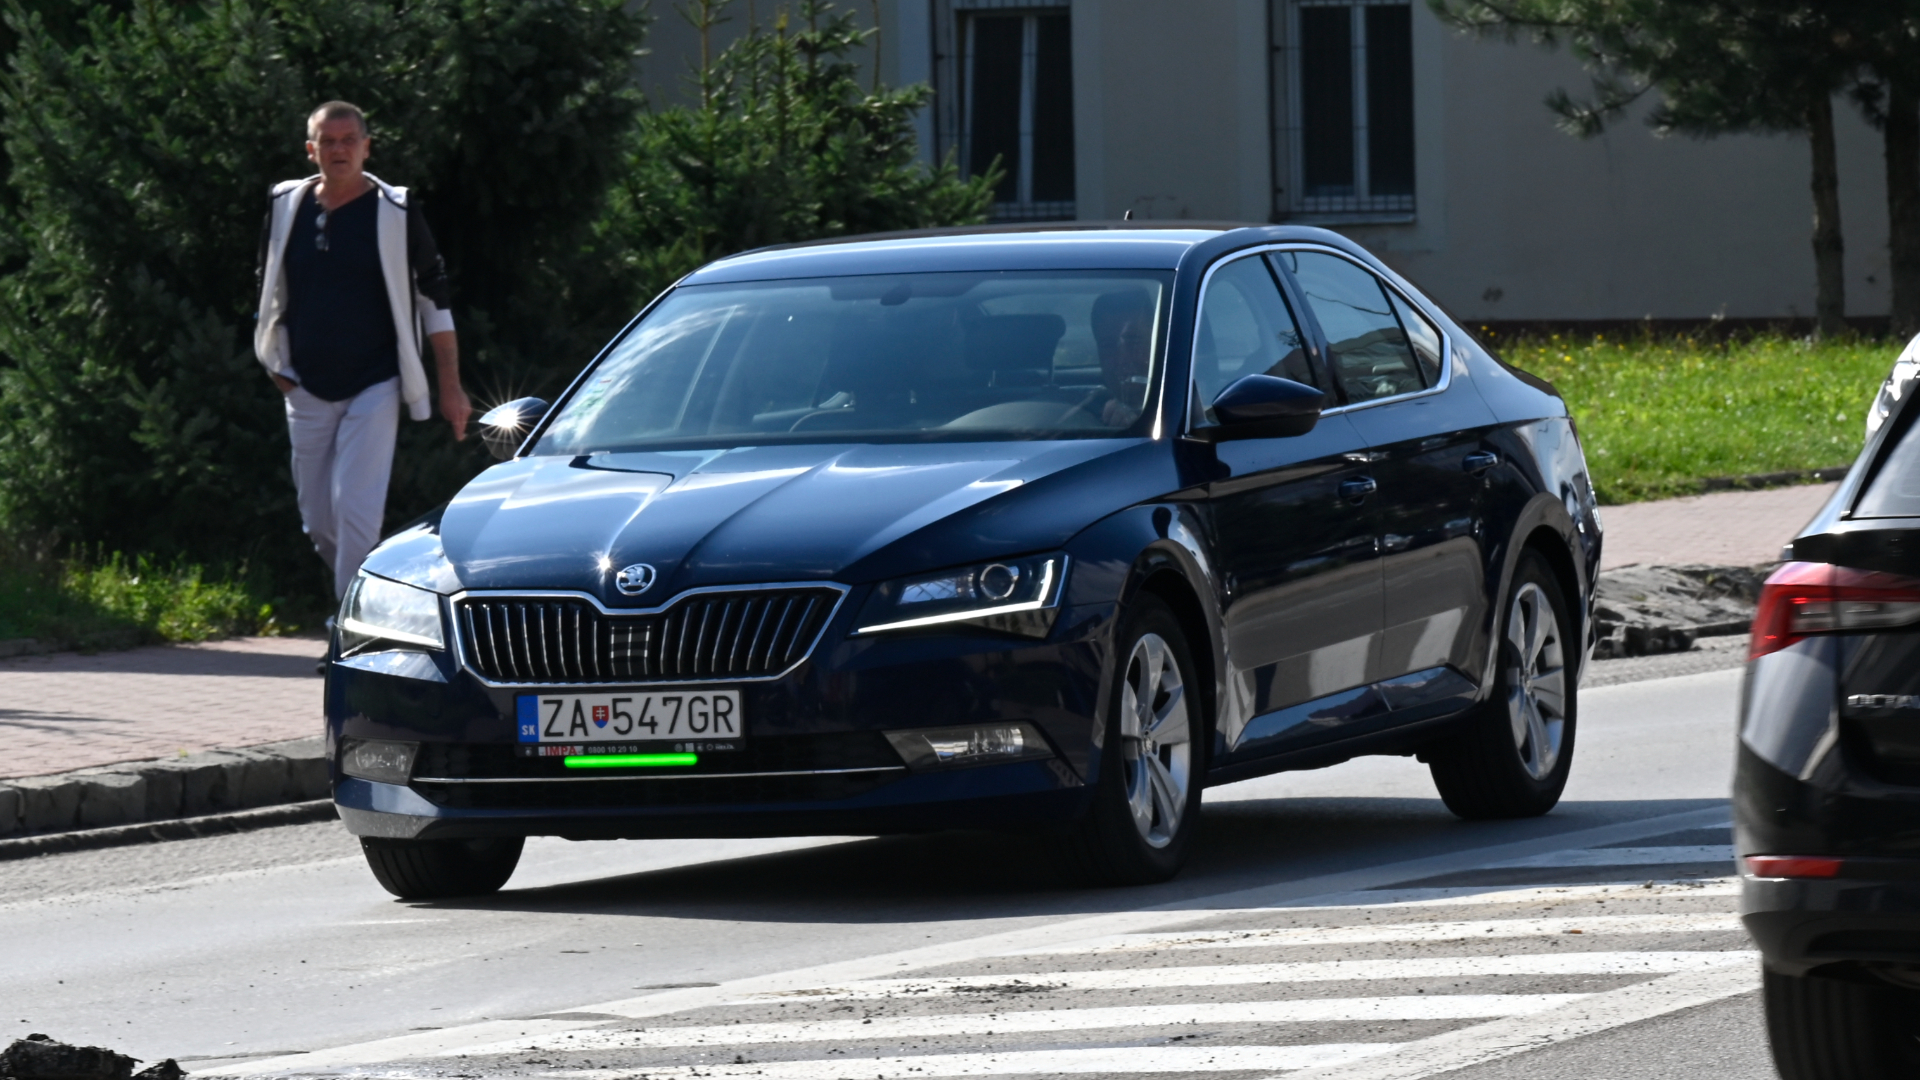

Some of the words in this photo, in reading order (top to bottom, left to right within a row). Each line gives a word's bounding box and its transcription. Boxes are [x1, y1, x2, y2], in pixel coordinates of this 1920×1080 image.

[543, 699, 589, 737] ZA
[612, 695, 734, 735] 547GR
[521, 724, 536, 736] SK
